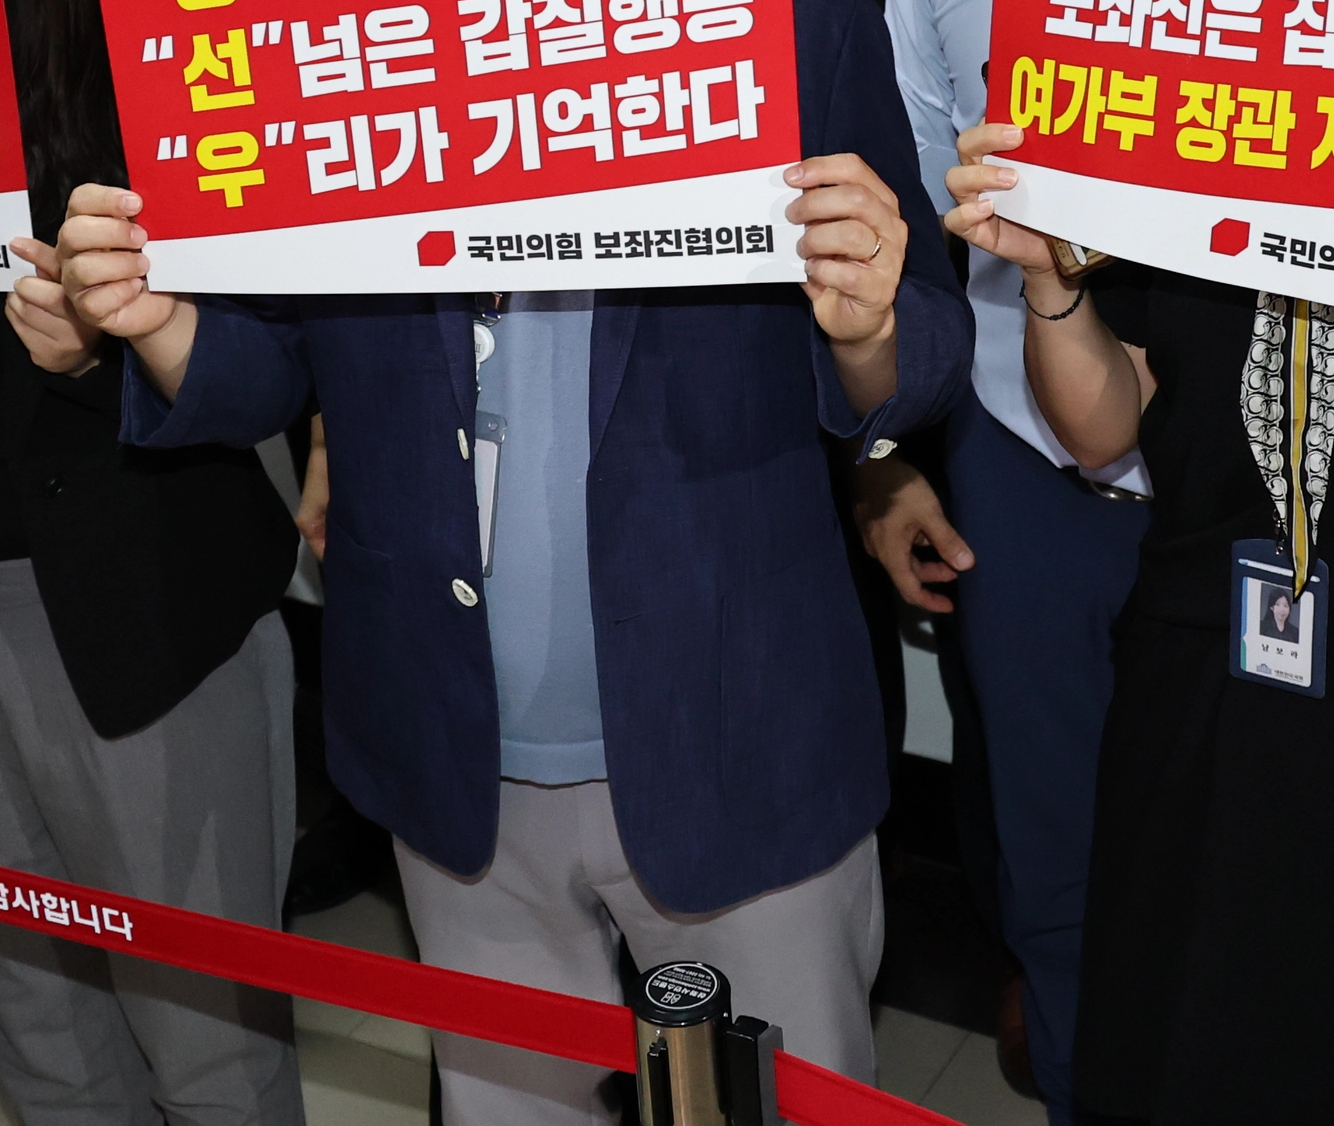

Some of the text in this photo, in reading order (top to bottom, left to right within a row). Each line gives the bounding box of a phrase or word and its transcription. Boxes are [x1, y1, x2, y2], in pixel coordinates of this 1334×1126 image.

[142, 4, 437, 113] “선”넘은
[1009, 55, 1159, 153] 여가부
[1175, 78, 1297, 172] 장관
[156, 59, 765, 209] “우”리가 기억한다
[467, 224, 775, 263] 국민의힘 보좌진협의회
